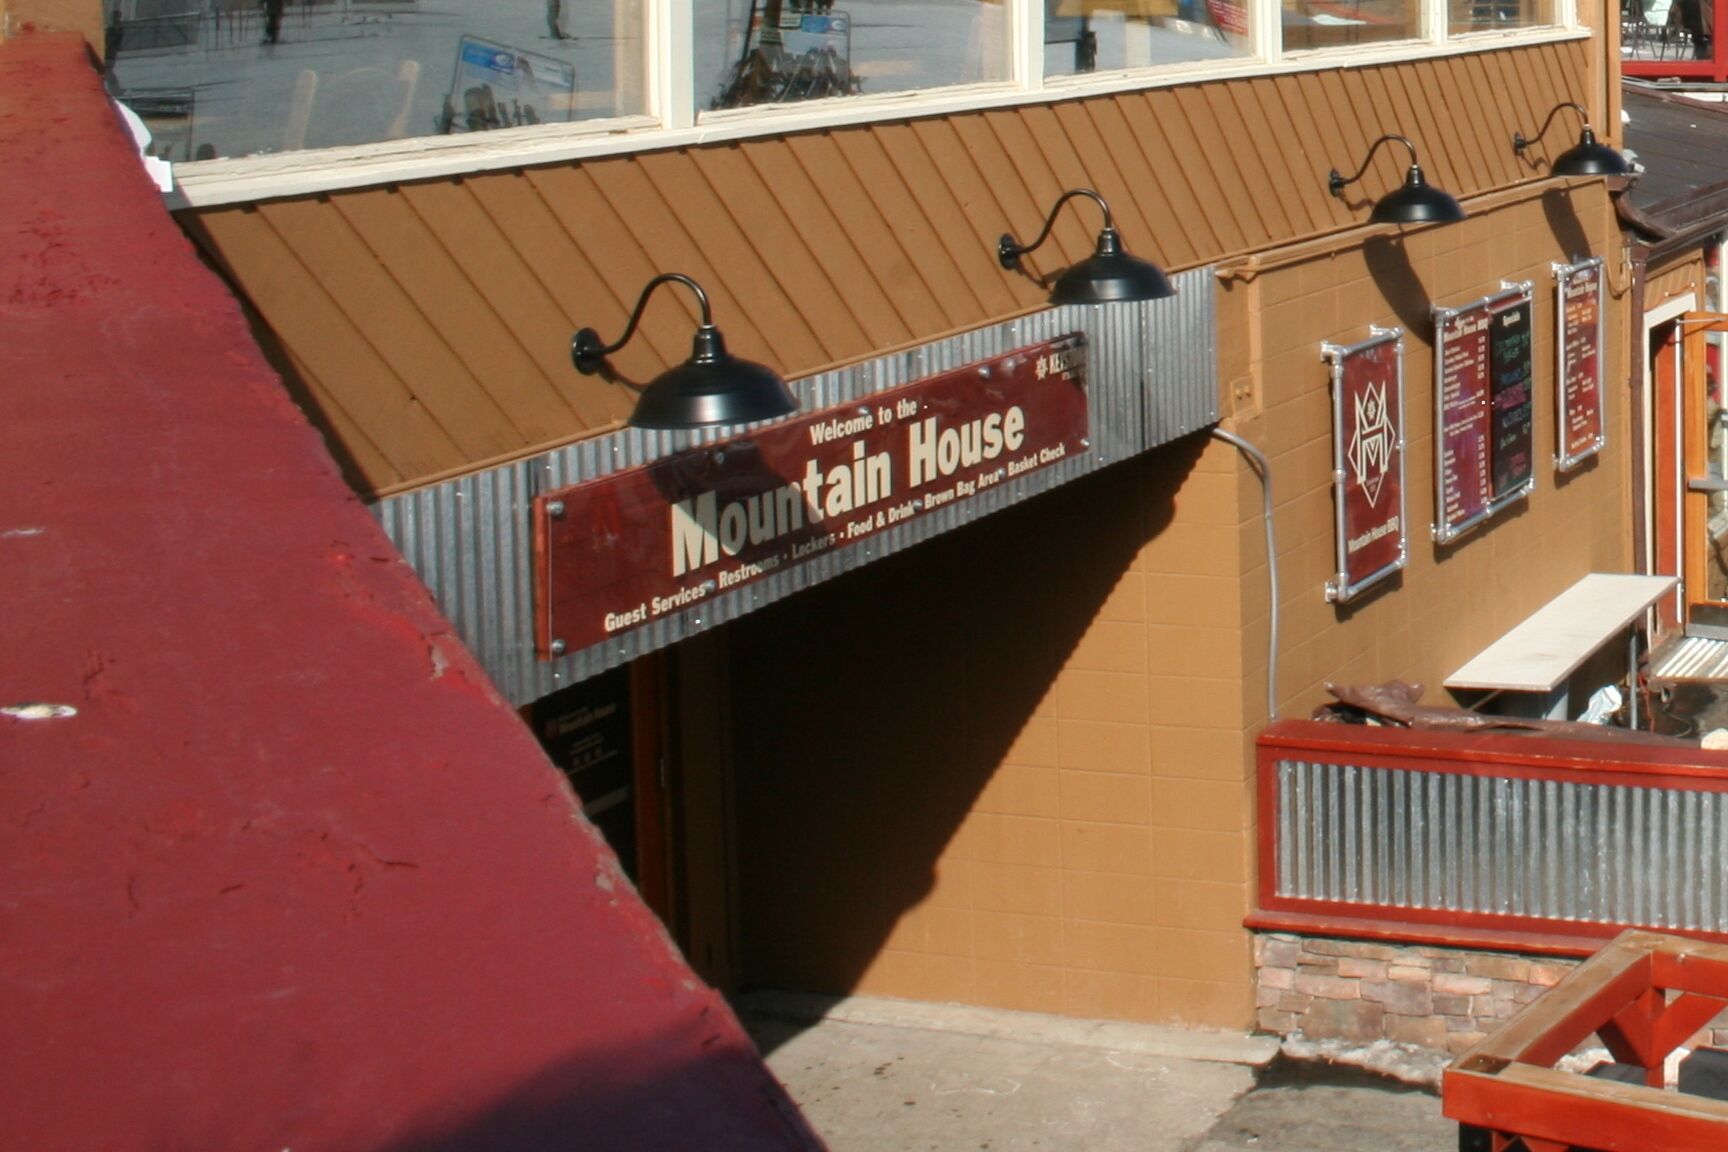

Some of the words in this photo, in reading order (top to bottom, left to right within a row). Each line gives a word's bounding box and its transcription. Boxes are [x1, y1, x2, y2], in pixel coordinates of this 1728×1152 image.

[671, 440, 892, 577] Mountain
[909, 405, 1025, 488] House
[810, 414, 873, 446] Welcome
[878, 406, 892, 425] to
[897, 398, 917, 419] the
[605, 603, 647, 632] Guest
[652, 582, 706, 615] Services
[719, 554, 779, 588] Restrooms
[792, 532, 836, 560] Lockers
[847, 515, 873, 539] Food
[876, 511, 885, 528] &
[924, 489, 955, 510] Brown
[957, 480, 976, 496] Bag
[978, 470, 999, 488] Area
[1008, 454, 1038, 476] Basket
[1040, 442, 1066, 462] Check
